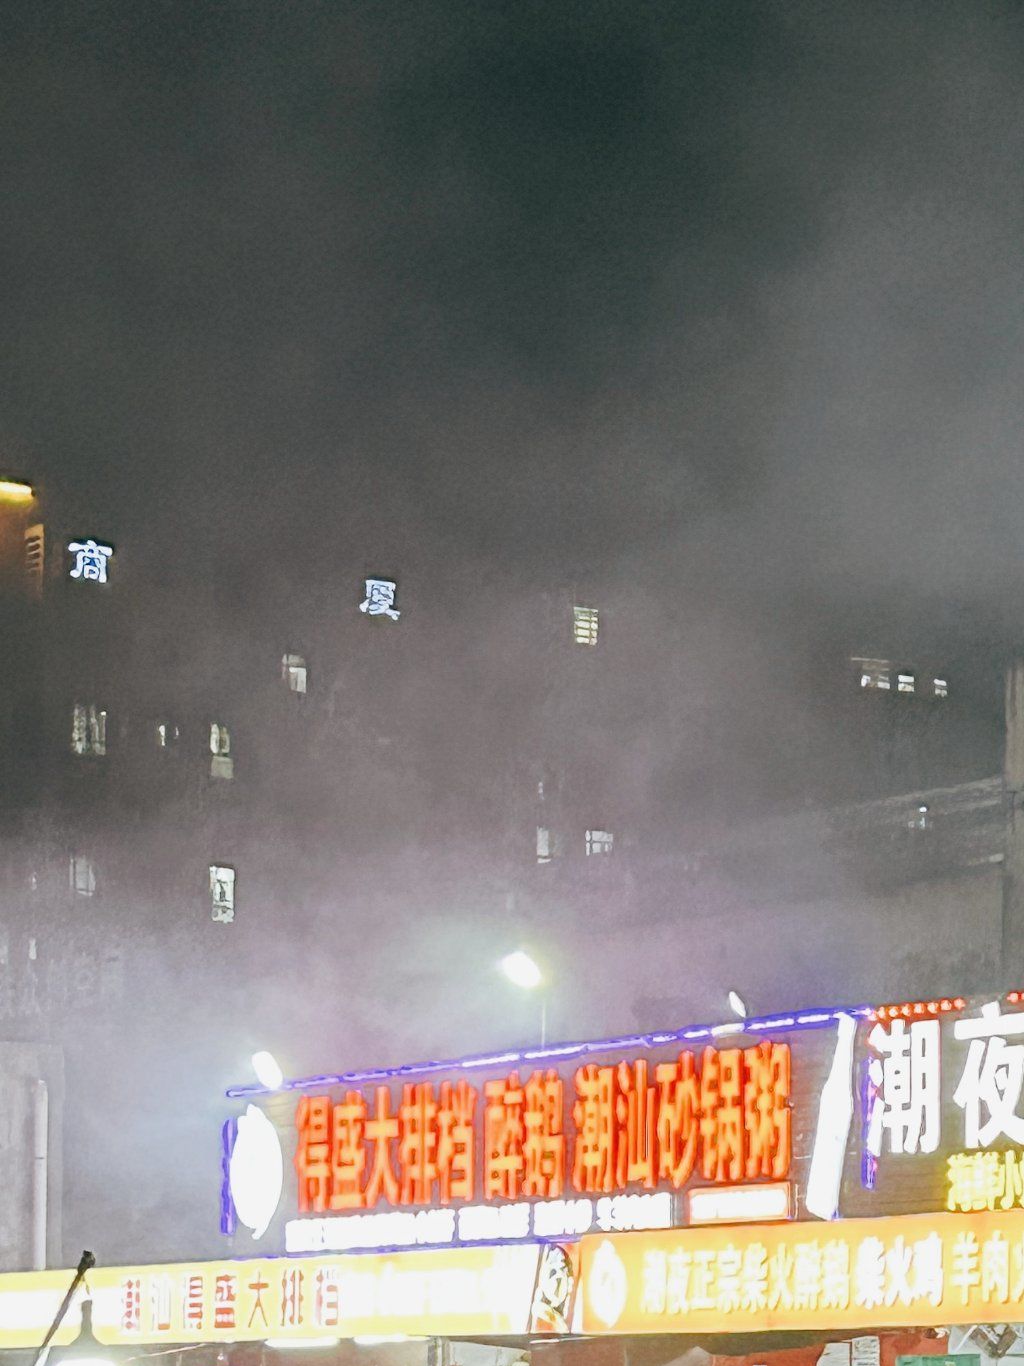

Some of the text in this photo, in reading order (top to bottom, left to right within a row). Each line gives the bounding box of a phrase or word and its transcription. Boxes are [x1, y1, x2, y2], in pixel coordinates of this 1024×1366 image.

[68, 539, 113, 583] 商
[295, 1039, 792, 1212] 得盛大排档 醉鹅 潮汕砂锅粥
